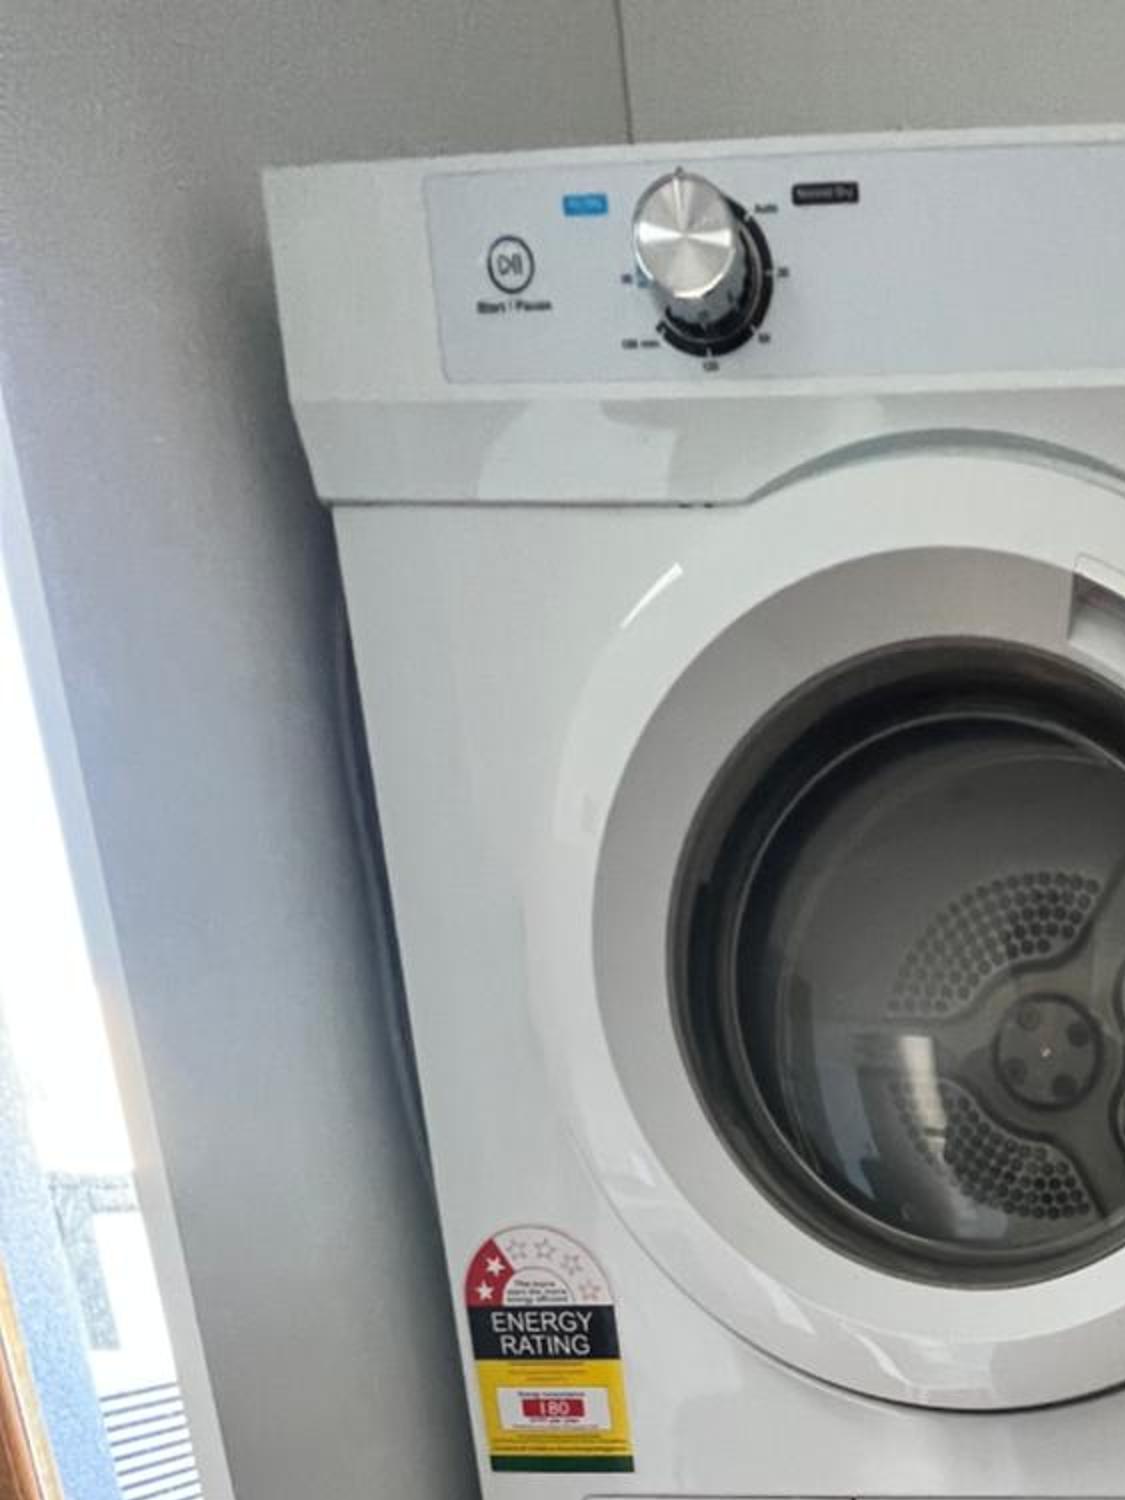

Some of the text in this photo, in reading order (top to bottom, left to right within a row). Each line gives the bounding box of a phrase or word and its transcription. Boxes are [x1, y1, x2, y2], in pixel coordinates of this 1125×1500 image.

[491, 1311, 593, 1333] ENERGY
[501, 1335, 591, 1356] RATING
[540, 1401, 570, 1415] 180
